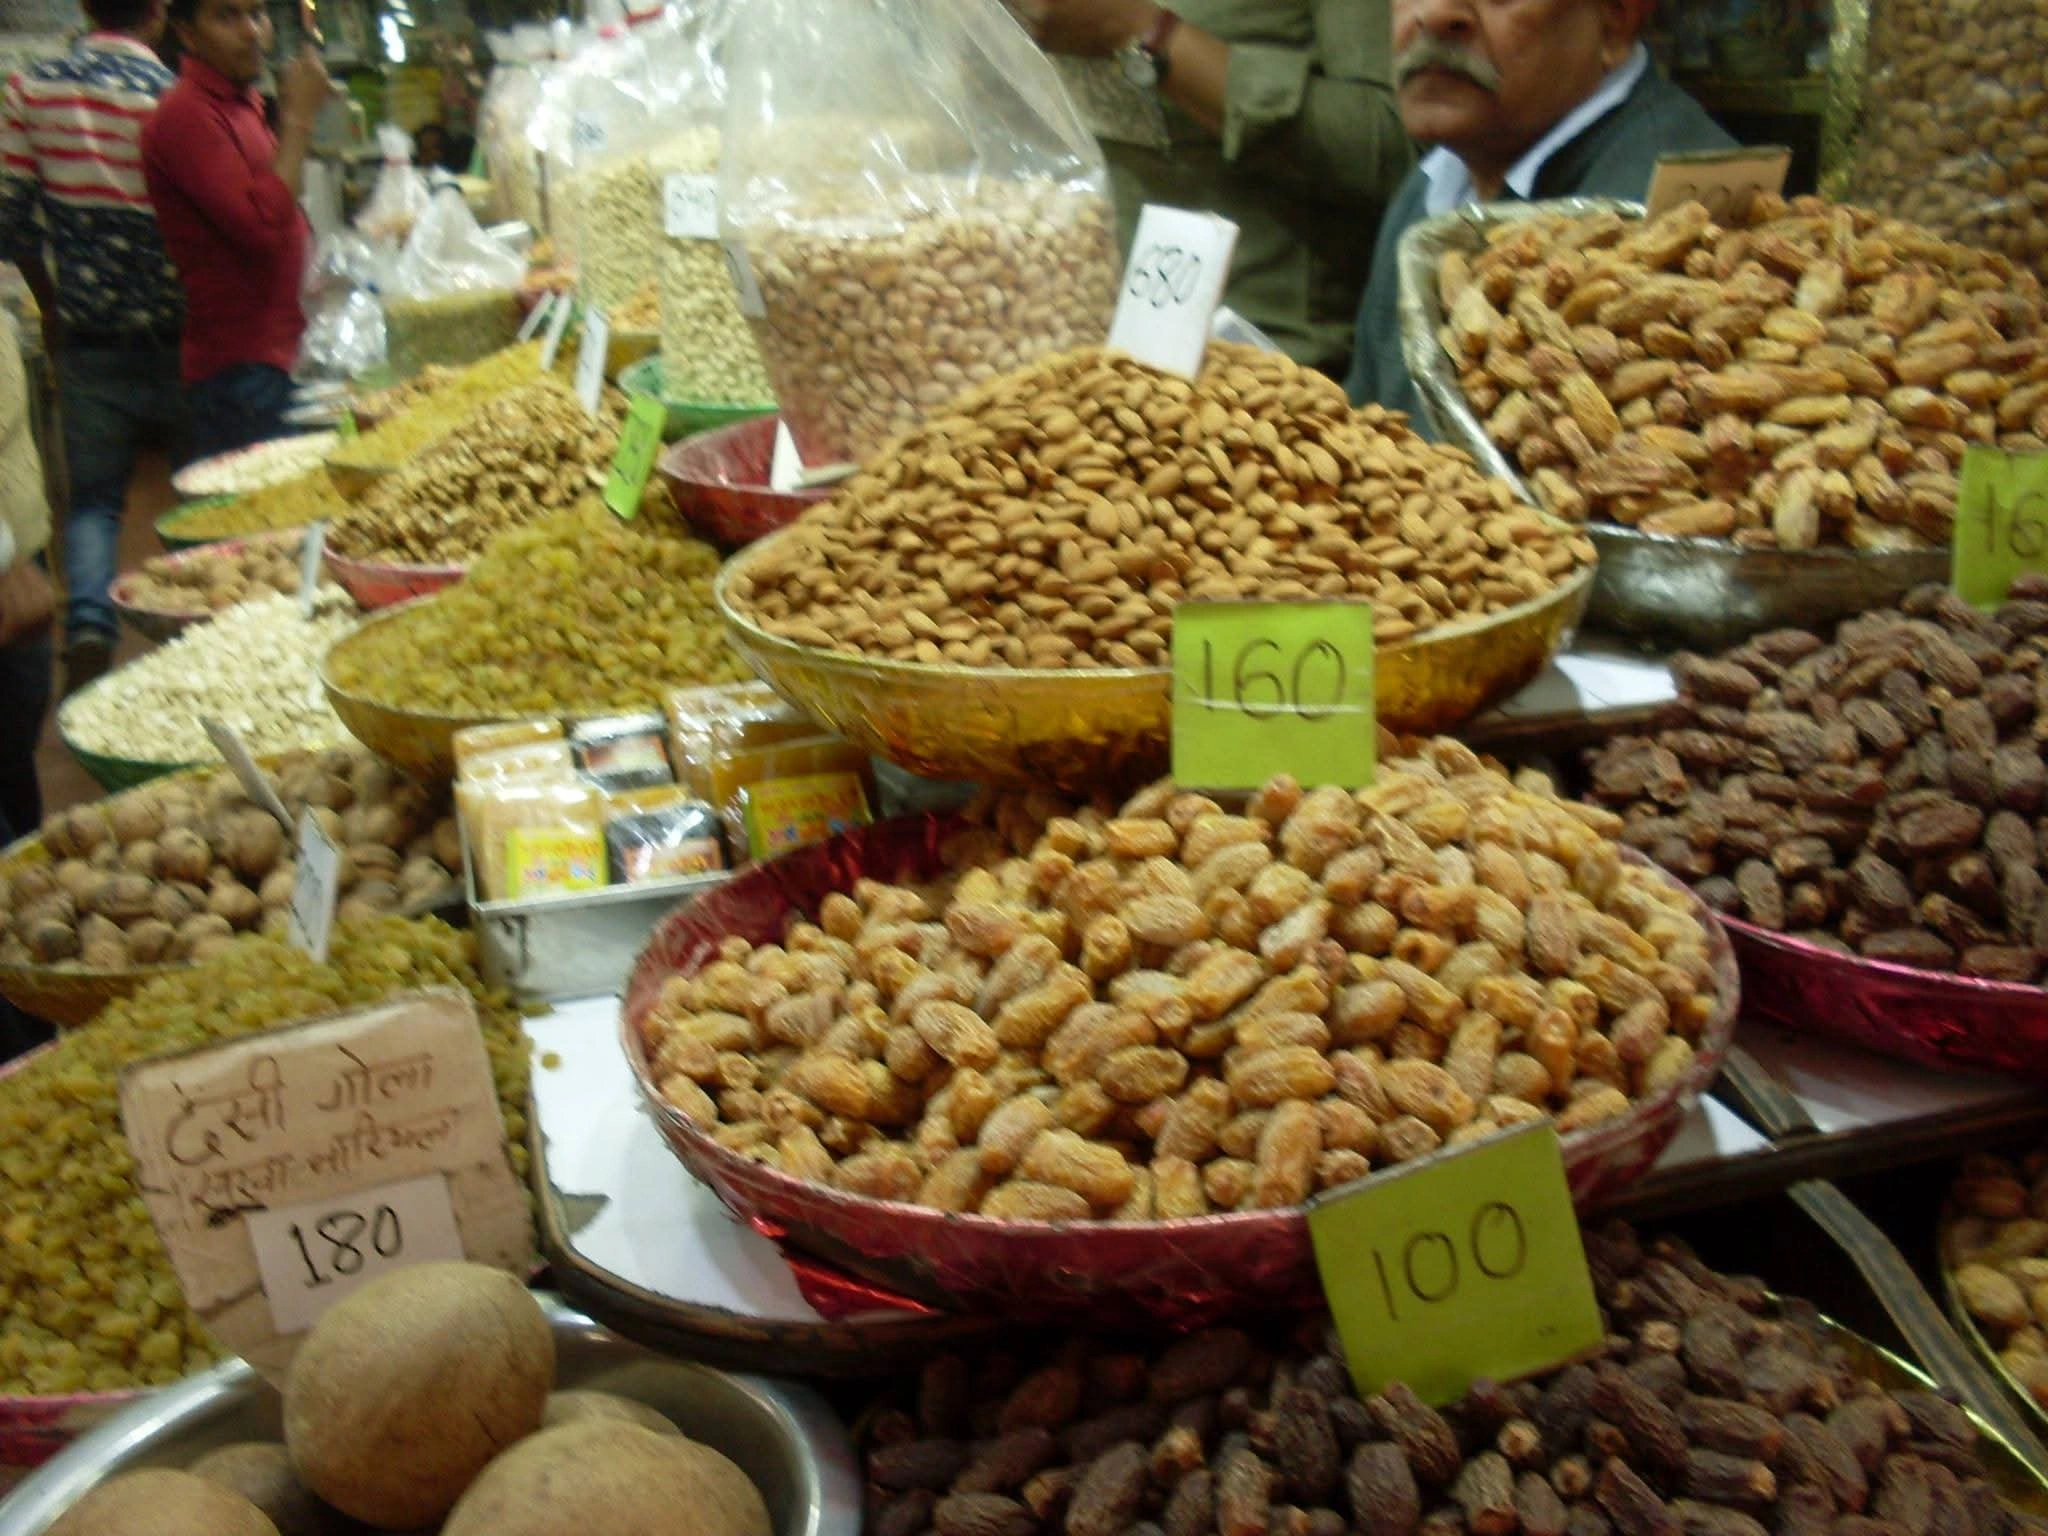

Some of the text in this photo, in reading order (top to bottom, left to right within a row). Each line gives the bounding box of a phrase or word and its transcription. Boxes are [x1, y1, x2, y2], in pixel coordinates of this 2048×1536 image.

[1202, 636, 1347, 722] 160
[165, 1043, 435, 1168] देसी गोला
[289, 1204, 404, 1289] 180
[1371, 1200, 1528, 1322] 100
